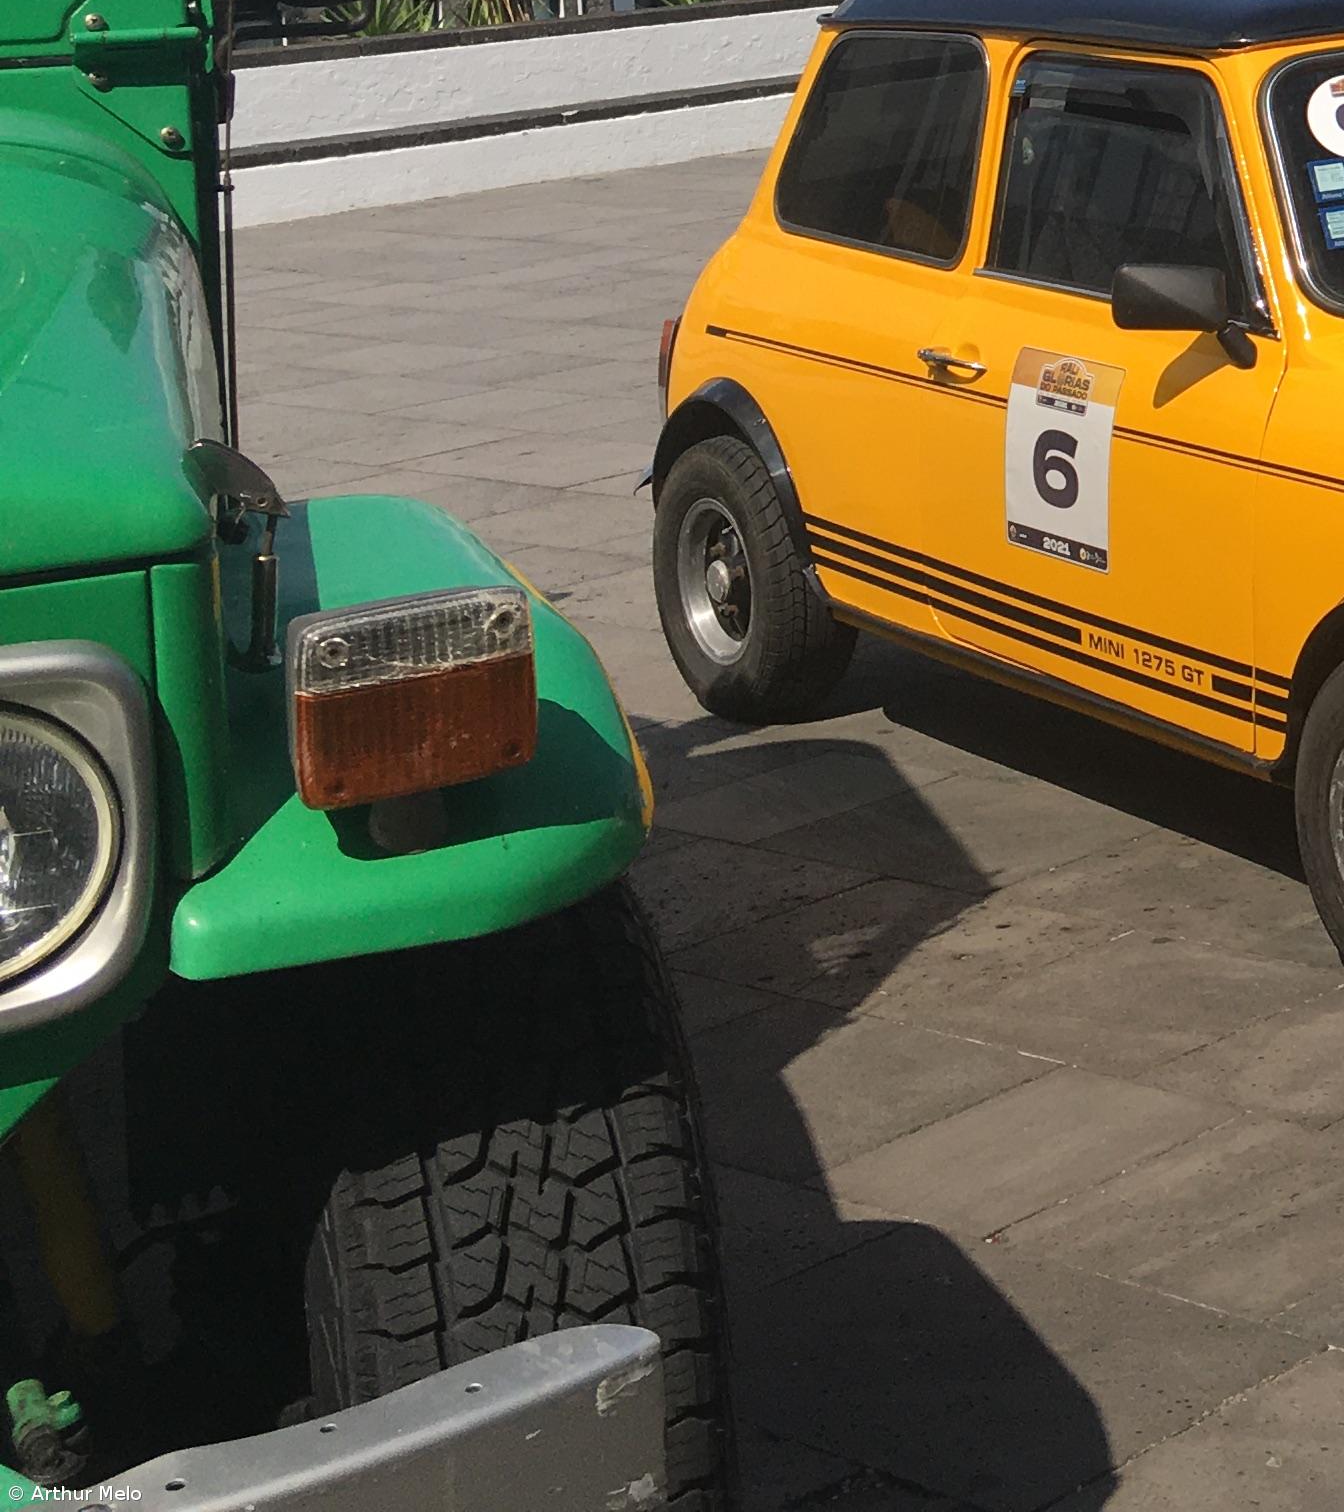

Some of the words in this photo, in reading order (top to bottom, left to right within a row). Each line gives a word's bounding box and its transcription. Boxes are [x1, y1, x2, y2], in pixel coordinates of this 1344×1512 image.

[1033, 429, 1079, 509] 6
[1042, 537, 1071, 556] 2021
[1088, 633, 1125, 659] MINI
[1134, 648, 1175, 676] 1275
[1181, 664, 1204, 686] GT
